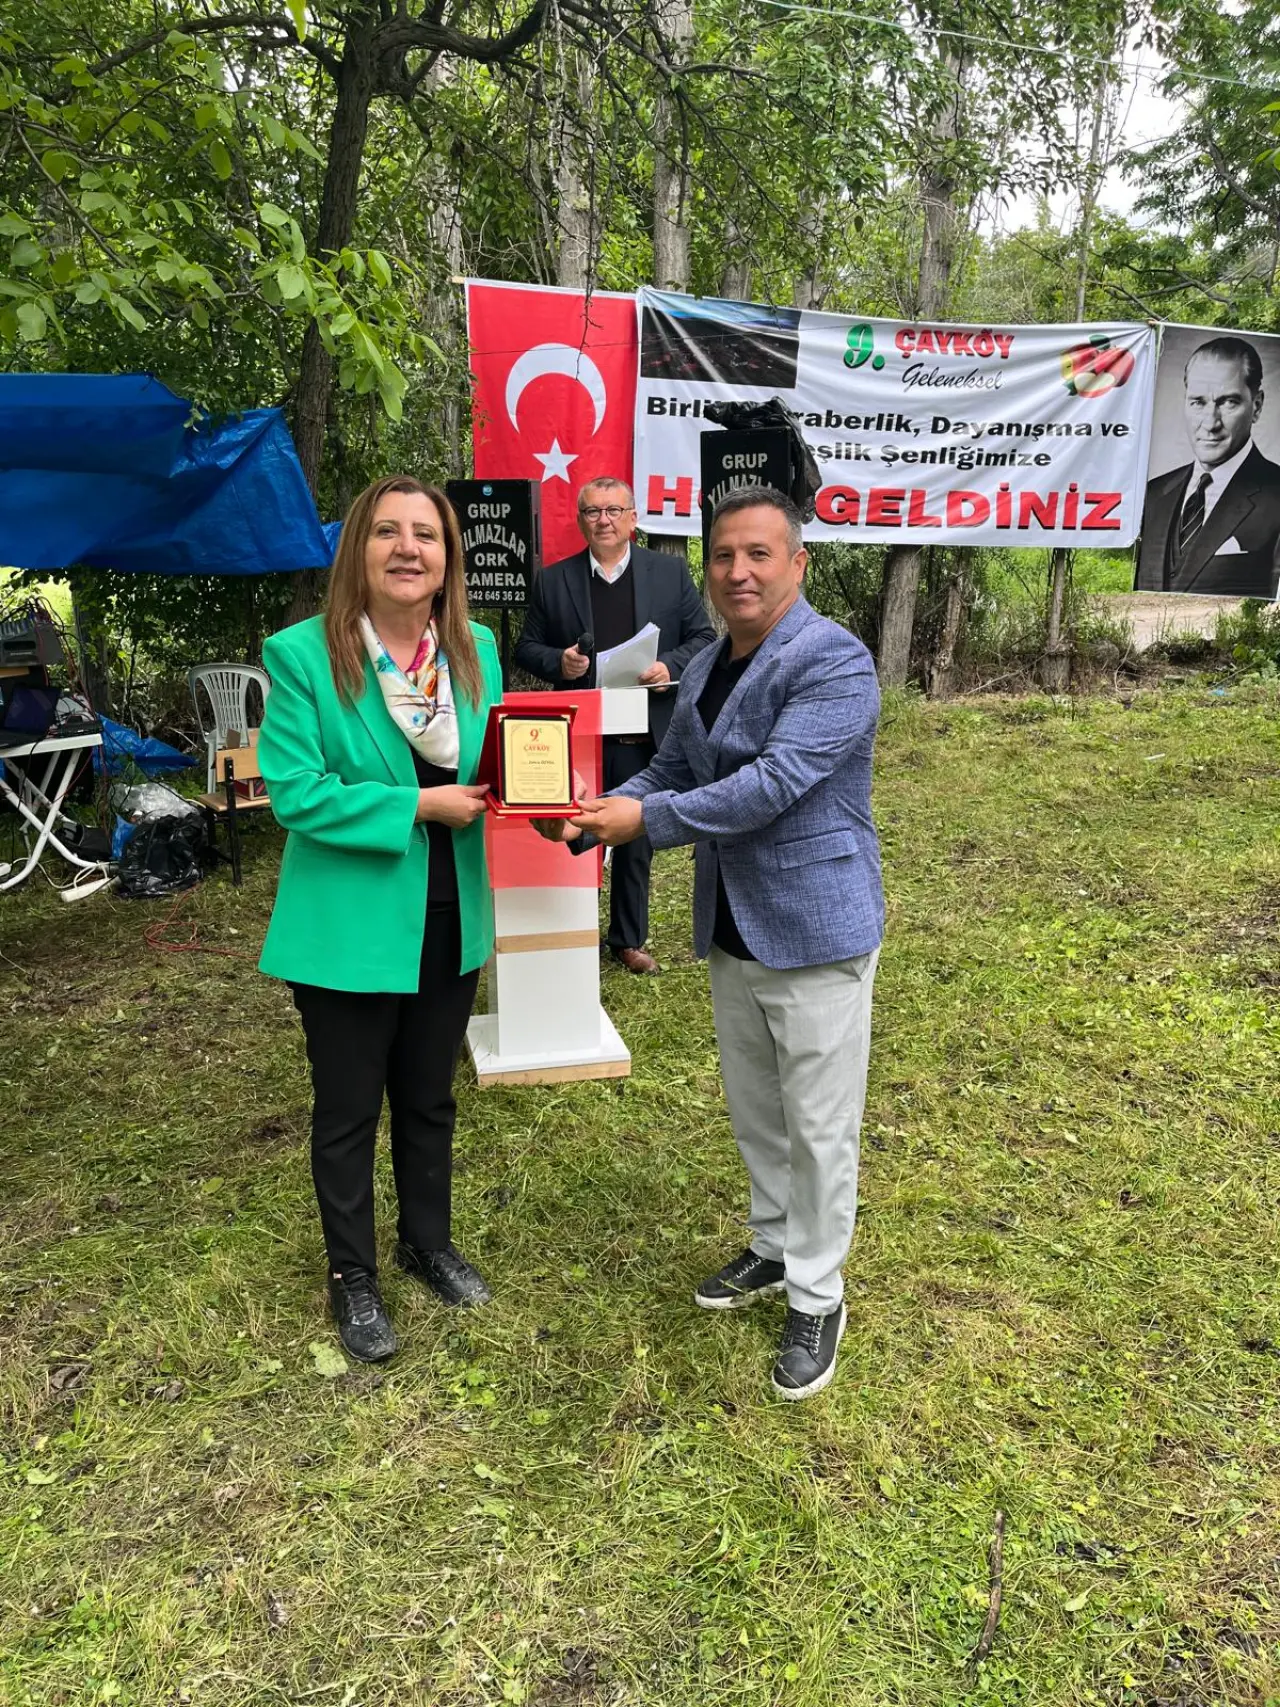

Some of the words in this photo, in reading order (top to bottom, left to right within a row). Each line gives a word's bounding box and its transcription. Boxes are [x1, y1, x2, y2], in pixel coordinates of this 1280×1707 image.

[843, 323, 886, 371] 9.
[894, 328, 1015, 359] ÇAYKÖY
[901, 362, 1004, 393] Geleneksel
[931, 416, 1092, 442] Dayanışma
[1101, 422, 1130, 437] ve
[722, 453, 768, 470] GRUP
[880, 444, 1051, 471] Şenliğimize
[467, 503, 511, 519] GRUP
[815, 482, 1122, 531] GELDİNİZ
[463, 523, 526, 564] ILMAZLAR
[474, 552, 509, 567] ORK
[485, 591, 500, 601] 645
[502, 591, 513, 601] 36
[514, 591, 525, 601] 23
